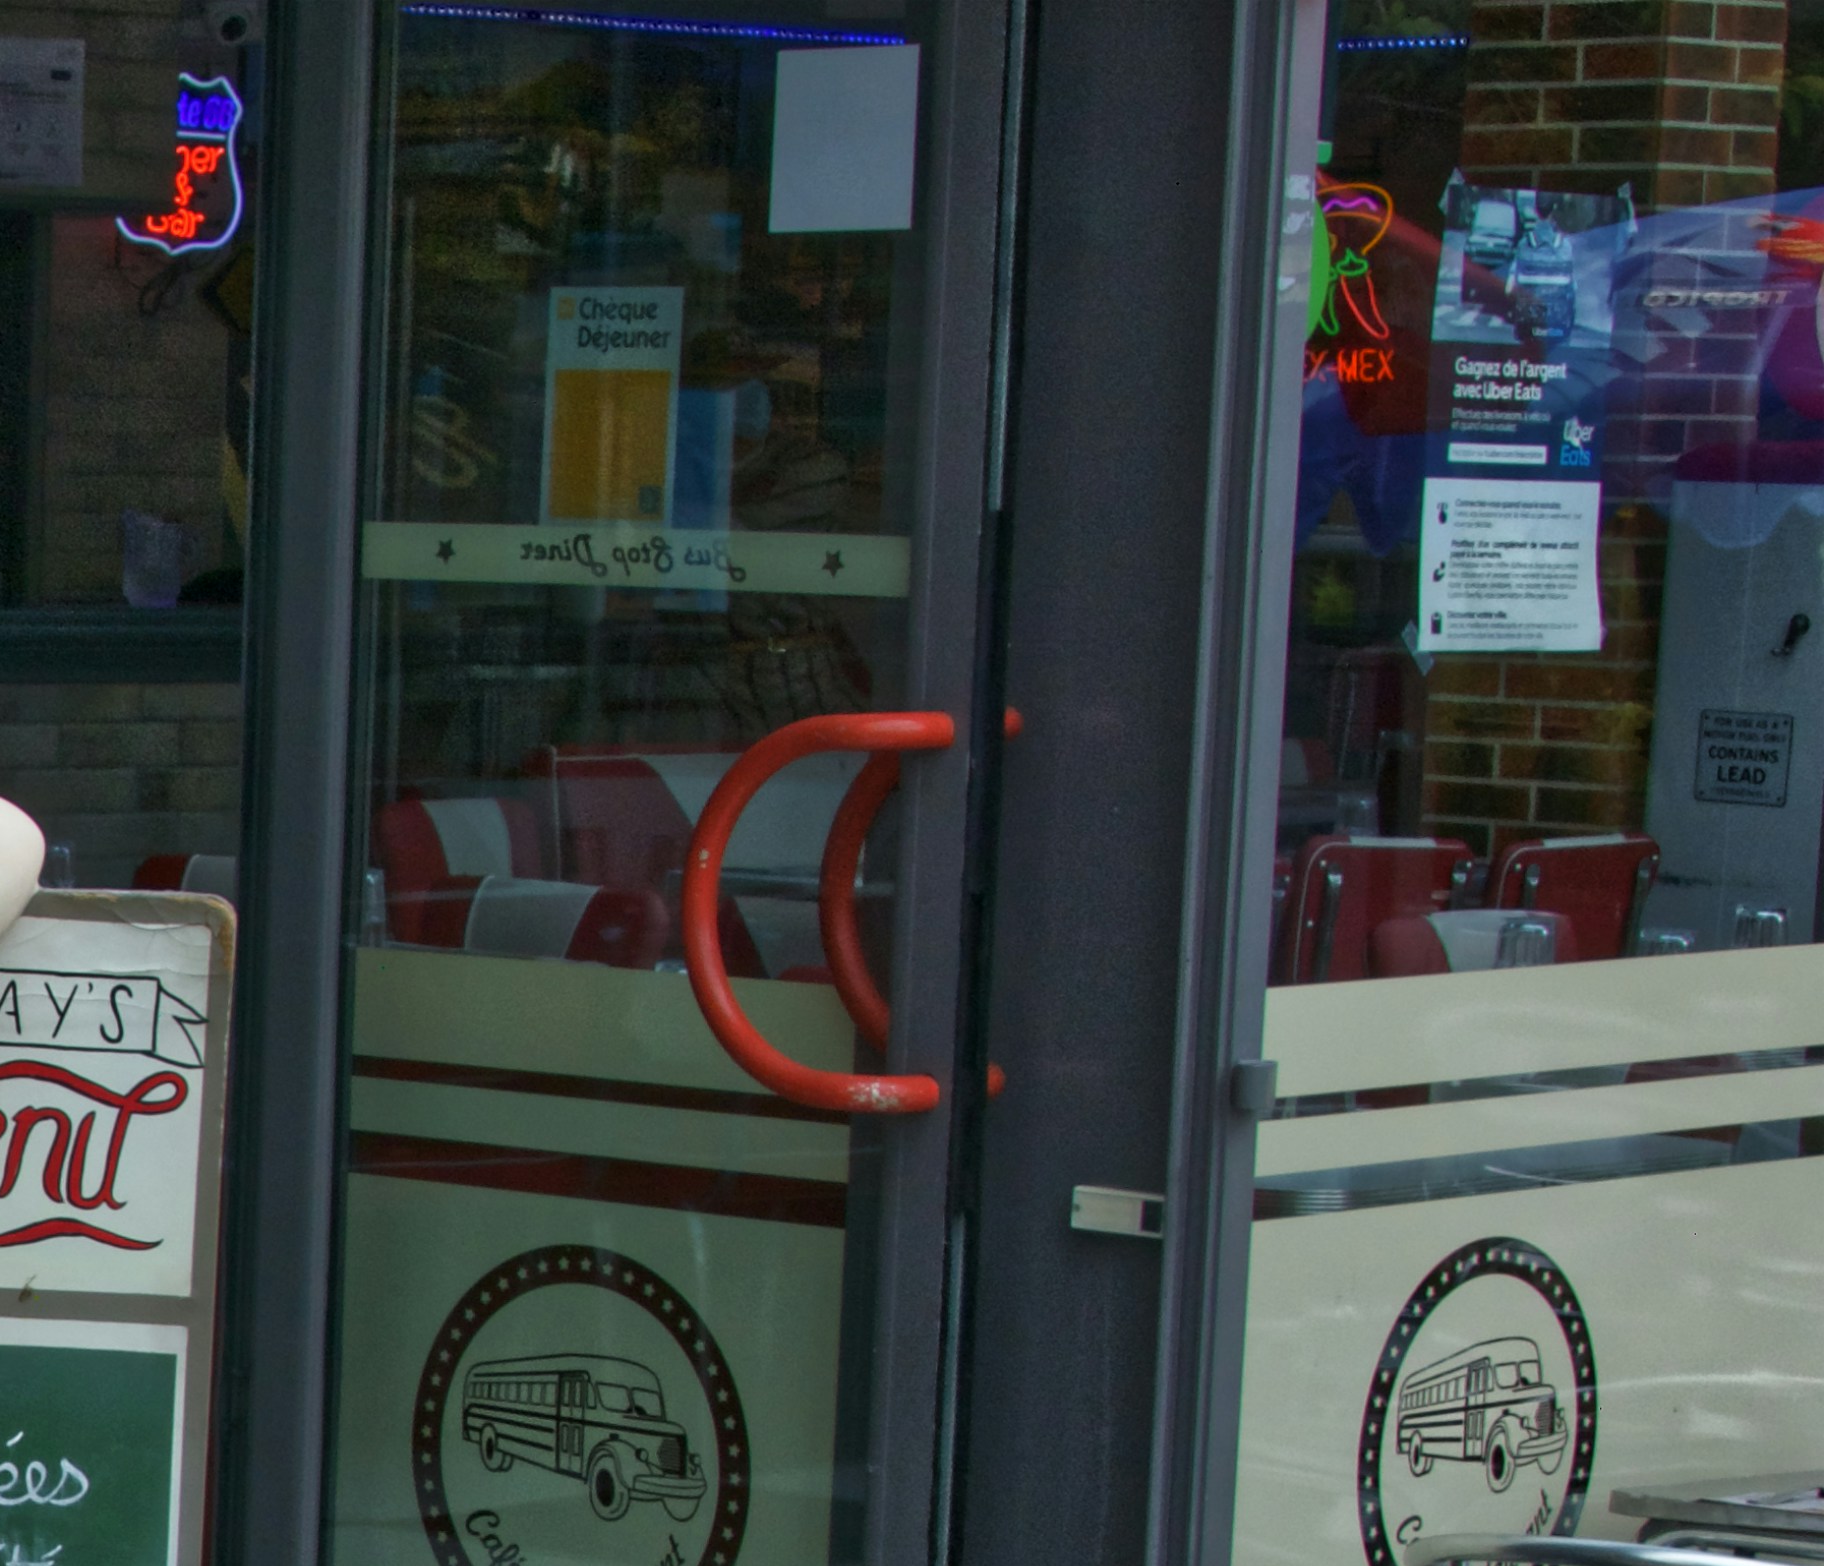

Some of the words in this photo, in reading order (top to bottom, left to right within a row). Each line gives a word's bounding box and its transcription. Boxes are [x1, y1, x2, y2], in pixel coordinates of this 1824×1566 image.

[578, 296, 659, 325] Chèque
[577, 324, 672, 354] Déjeuner
[1304, 347, 1395, 383] X-MEX
[1454, 355, 1500, 381] Gagnez
[1502, 359, 1518, 379] de
[1453, 382, 1483, 399] avec
[1483, 380, 1514, 401] Uber
[1514, 381, 1543, 401] Eats
[1559, 443, 1592, 467] Eats
[1708, 745, 1779, 764] CONTAINS
[1716, 765, 1767, 785] LEAD
